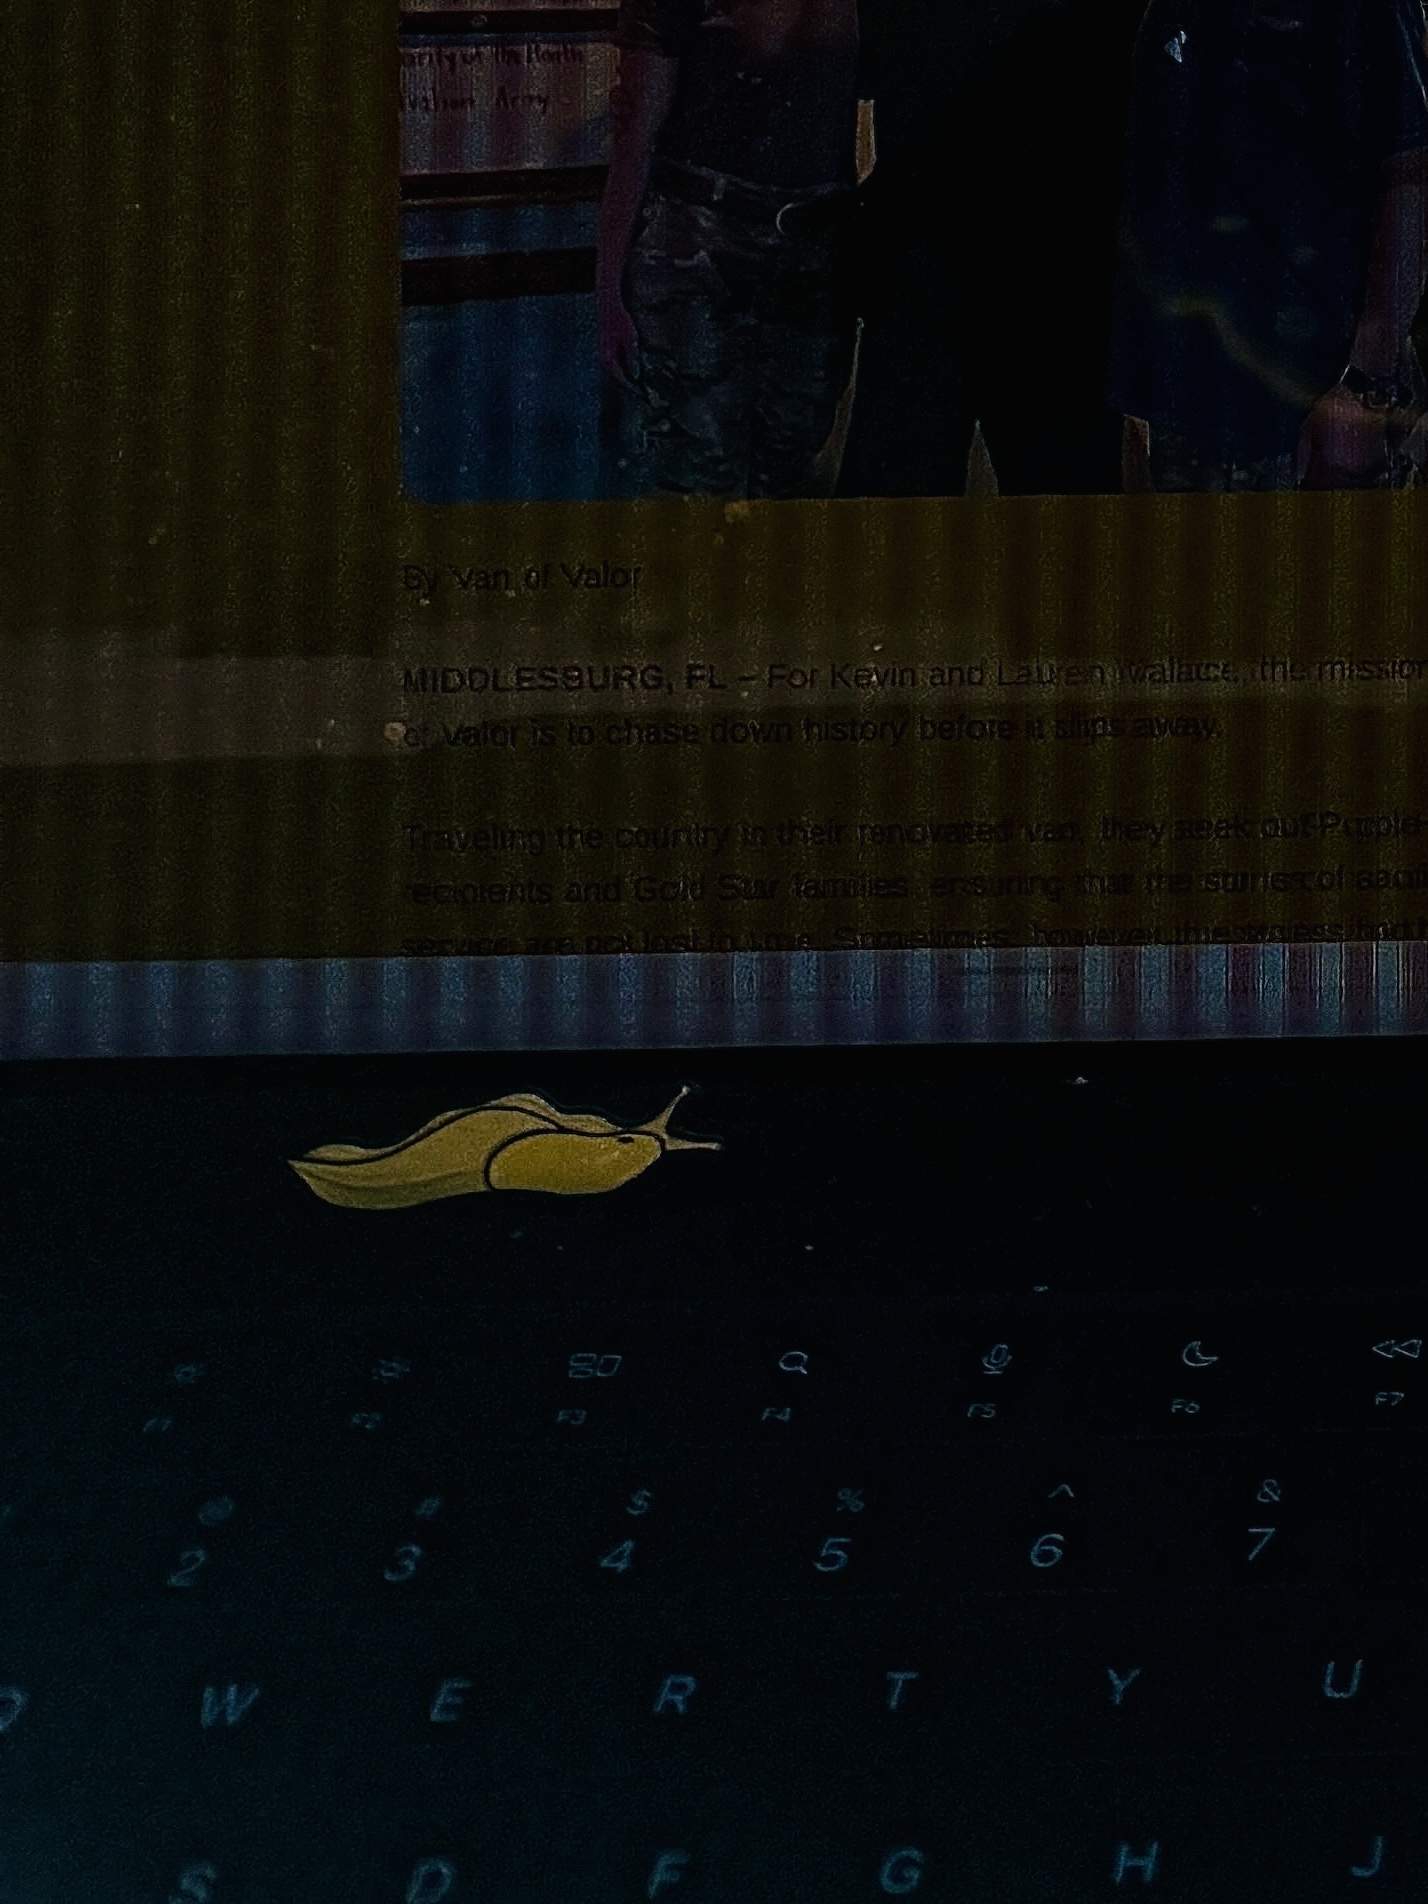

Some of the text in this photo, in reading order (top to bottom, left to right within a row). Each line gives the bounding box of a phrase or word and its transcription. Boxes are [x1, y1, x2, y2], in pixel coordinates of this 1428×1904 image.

[402, 664, 674, 695] MIDDLESBURG,
[684, 664, 728, 690] FL
[767, 663, 817, 689] For
[831, 662, 916, 688] Kevin
[929, 661, 985, 686] and
[530, 720, 557, 746] is
[567, 721, 595, 746] to
[604, 718, 701, 745] chase
[709, 717, 794, 744] down
[803, 714, 910, 747] history
[918, 712, 1014, 741] before
[404, 822, 546, 854] Traveling
[556, 822, 602, 849] the
[565, 879, 623, 904] and
[633, 874, 706, 903] Gold
[966, 1402, 998, 1419] F5
[1170, 1398, 1201, 1414] F6
[1373, 1390, 1406, 1407] F7
[1255, 1477, 1284, 1505] &
[167, 1547, 207, 1588] 2
[384, 1542, 424, 1583] 3
[599, 1538, 638, 1574] 4
[812, 1535, 852, 1573] 5
[1028, 1532, 1066, 1569] 6
[1246, 1527, 1278, 1562] 7
[201, 1683, 261, 1728] W
[428, 1677, 473, 1723] E
[652, 1672, 698, 1716] R
[884, 1669, 919, 1711] T
[1105, 1665, 1141, 1707] Y
[1321, 1657, 1364, 1700] U
[169, 1859, 217, 1904] S
[405, 1854, 458, 1904] D
[645, 1848, 690, 1900] F
[878, 1845, 925, 1895] G
[1111, 1839, 1162, 1887] H
[1349, 1833, 1388, 1879] J
